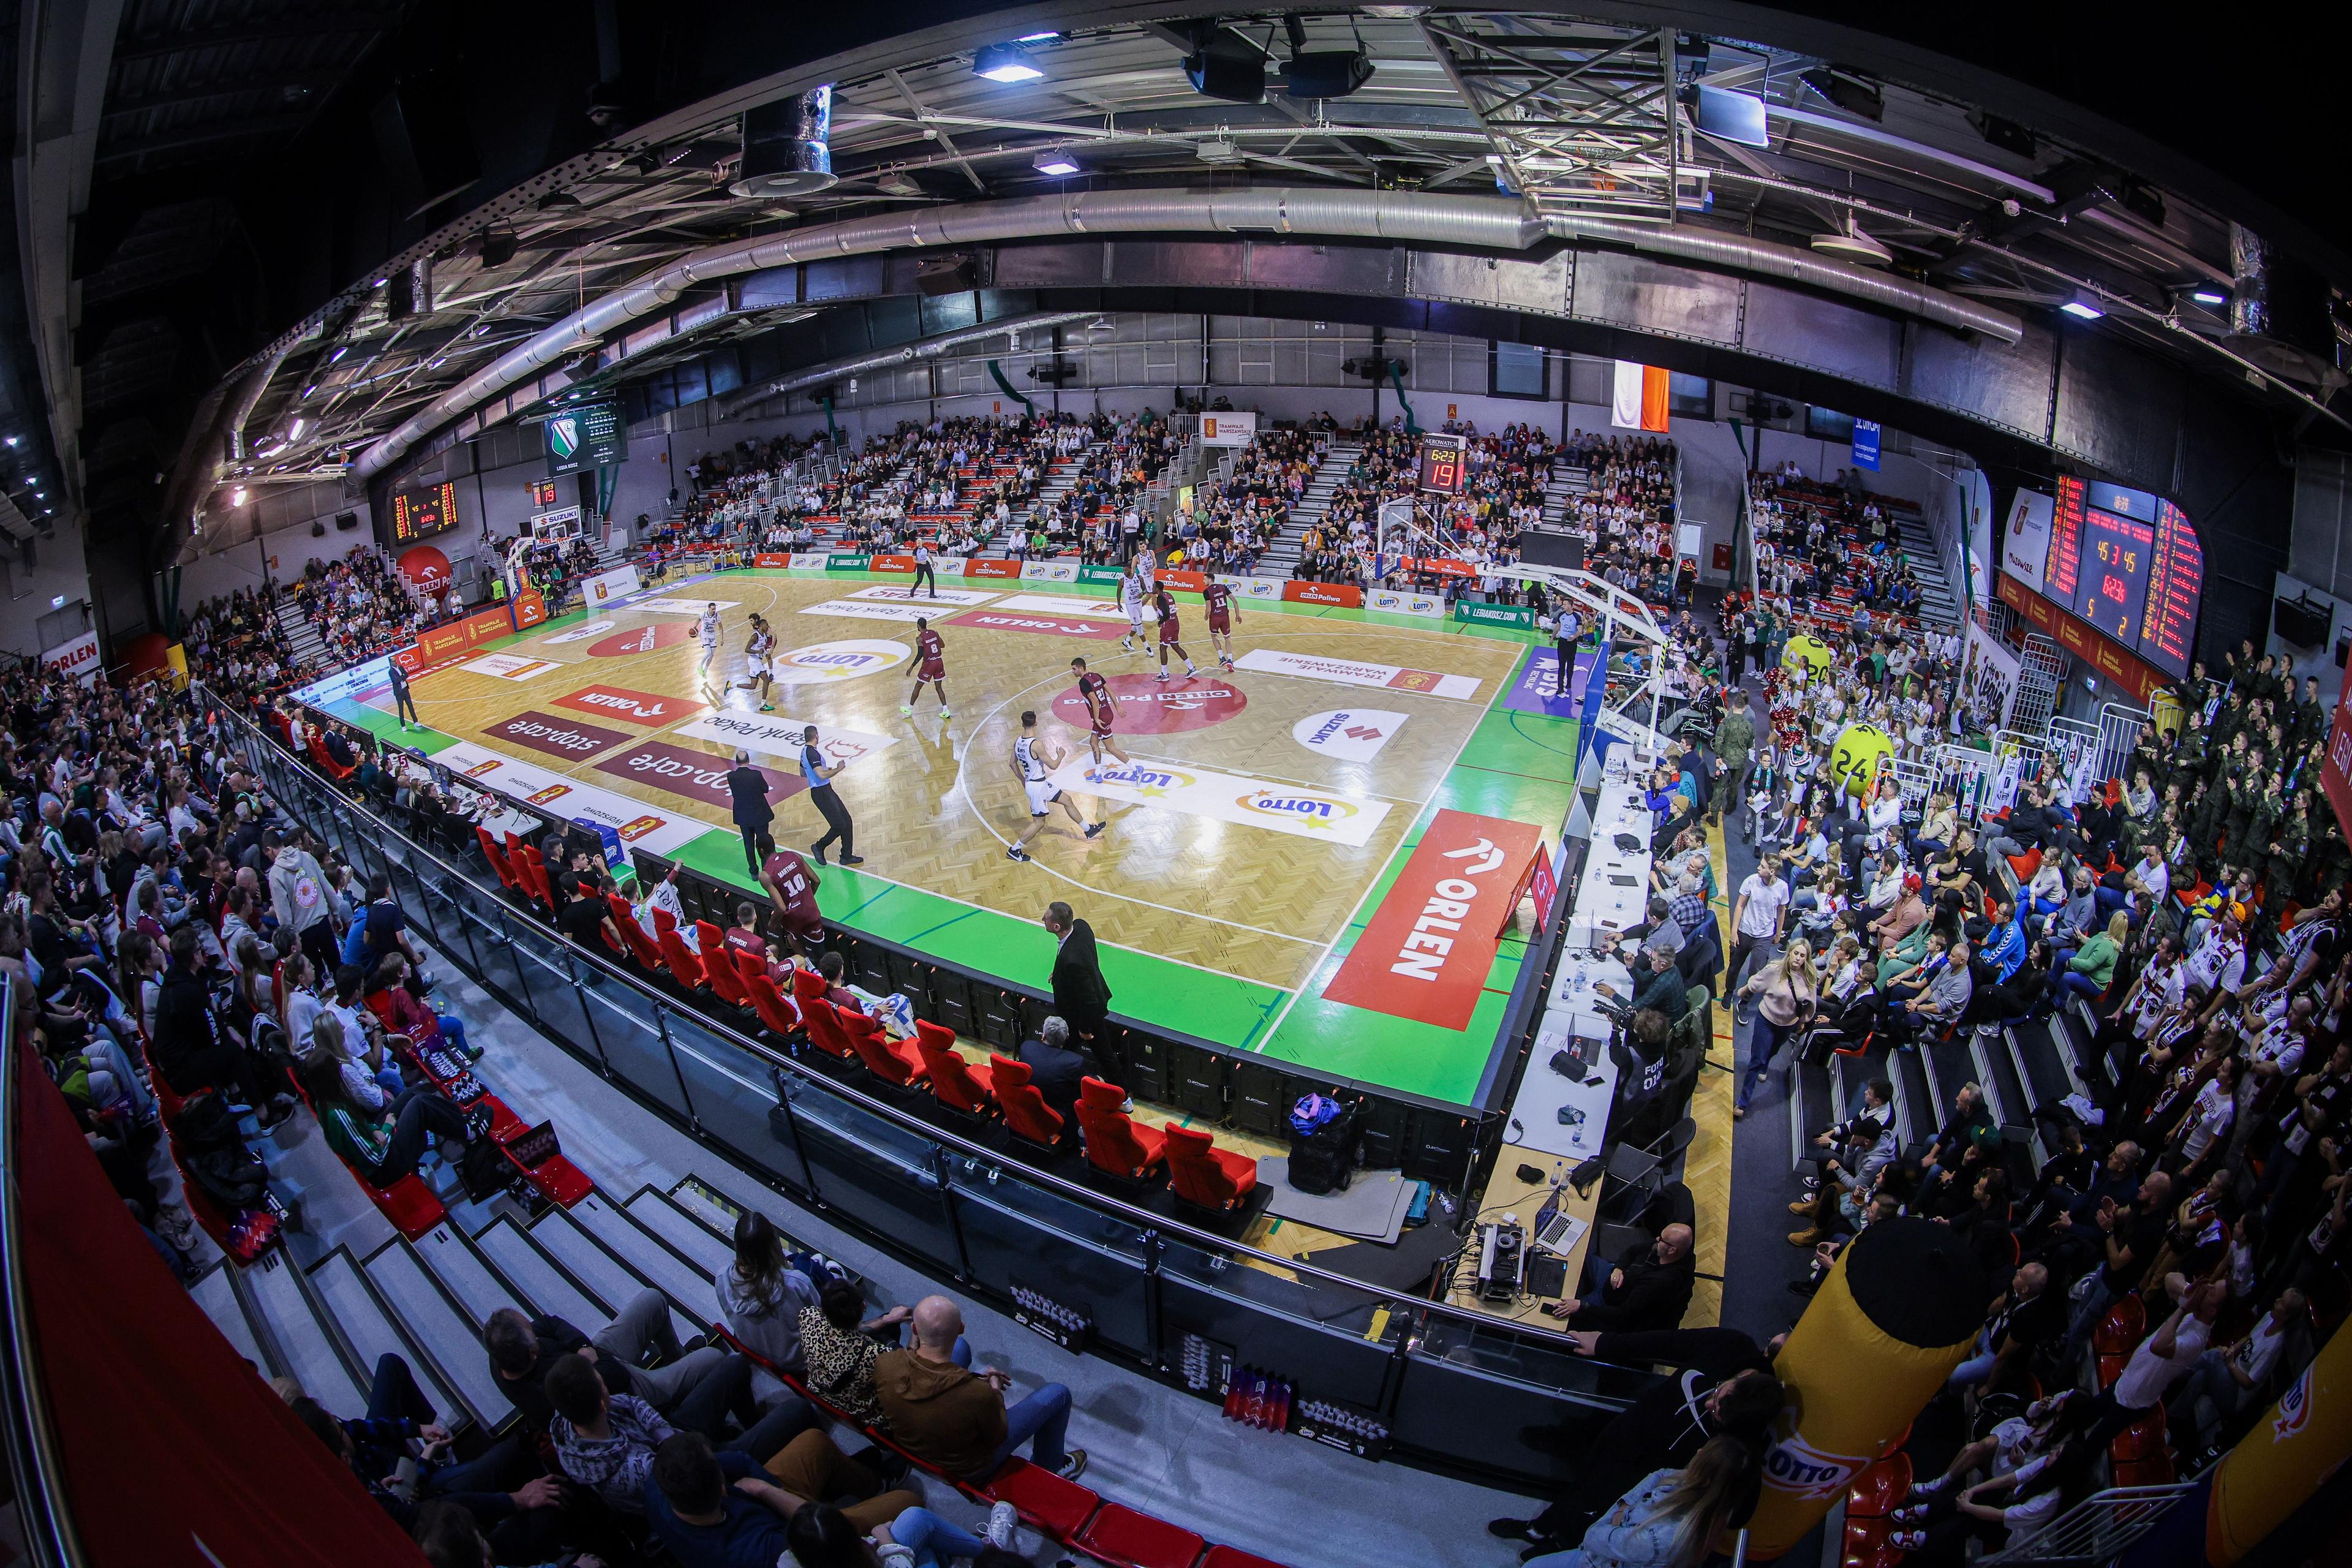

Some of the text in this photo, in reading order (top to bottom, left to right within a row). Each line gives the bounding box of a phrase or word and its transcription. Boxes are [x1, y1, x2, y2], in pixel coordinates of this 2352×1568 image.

[1425, 438, 1458, 447] AEROWATCH
[1431, 450, 1455, 462] 6:23
[1433, 465, 1454, 486] 19
[545, 491, 554, 502] 19
[549, 511, 577, 522] SUZUKI
[2098, 540, 2136, 573] 45 3 45
[607, 580, 628, 590] Warszawa
[1215, 598, 1227, 608] 11
[1578, 592, 1594, 604] Sports
[524, 614, 538, 623] ORLEN
[975, 617, 1057, 628] ORLEN
[1472, 608, 1517, 622] LEGIAKOSZ.COM
[2087, 598, 2127, 636] 5 2
[478, 619, 500, 630] TRAMWAJE
[479, 621, 508, 635] WARSZAWSKIE
[433, 634, 456, 646] TRAMWAJE
[434, 636, 464, 651] WARSZAWSKIE
[931, 644, 938, 654] 8
[50, 642, 97, 673] ORLEN
[797, 654, 875, 666] LOTTO
[2103, 650, 2119, 665] TRAMWAJE
[407, 655, 468, 680] ORLEN
[1277, 657, 1387, 676] WARSZAWSKIE
[1299, 665, 1383, 680] TRAMWAJE
[2102, 657, 2122, 676] WARSZAWSKIE
[578, 693, 639, 709] ORLEN
[1163, 691, 1227, 699] ORLEN
[507, 720, 602, 751] stop.cafe
[703, 715, 807, 746] Pekao Bank
[1307, 713, 1351, 745] SUZUKI
[399, 756, 406, 767] 5
[452, 755, 477, 767] Warszawa
[1836, 748, 1868, 783] 24
[508, 777, 540, 793] Warszawa
[1104, 770, 1173, 787] LOTTO
[1257, 798, 1333, 817] LOTTO
[582, 807, 625, 826] Warszawa
[777, 861, 797, 878] MARTINEZ
[783, 873, 806, 898] 10
[1390, 878, 1477, 981] ORLEN
[728, 935, 748, 948] SŁUPIŃSKI
[1645, 1057, 1664, 1076] FOTO
[1769, 1449, 1839, 1483] OTTO
